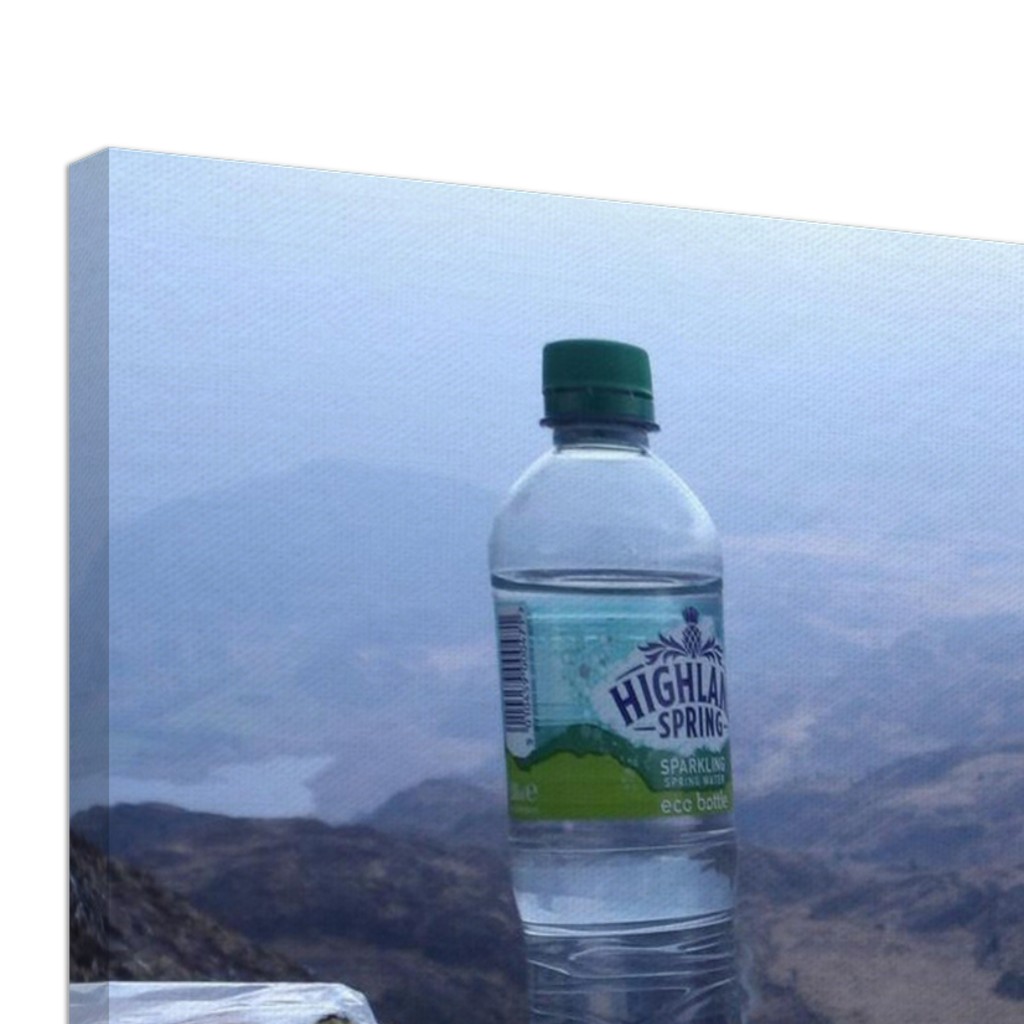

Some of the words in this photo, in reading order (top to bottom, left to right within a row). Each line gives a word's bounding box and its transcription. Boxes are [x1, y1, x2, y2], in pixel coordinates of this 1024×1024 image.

[658, 706, 725, 739] SPRING
[660, 756, 725, 776] SPARKLING
[663, 776, 700, 788] SPRING
[702, 774, 725, 787] WATER
[660, 797, 692, 814] eco
[696, 790, 728, 811] bottle
